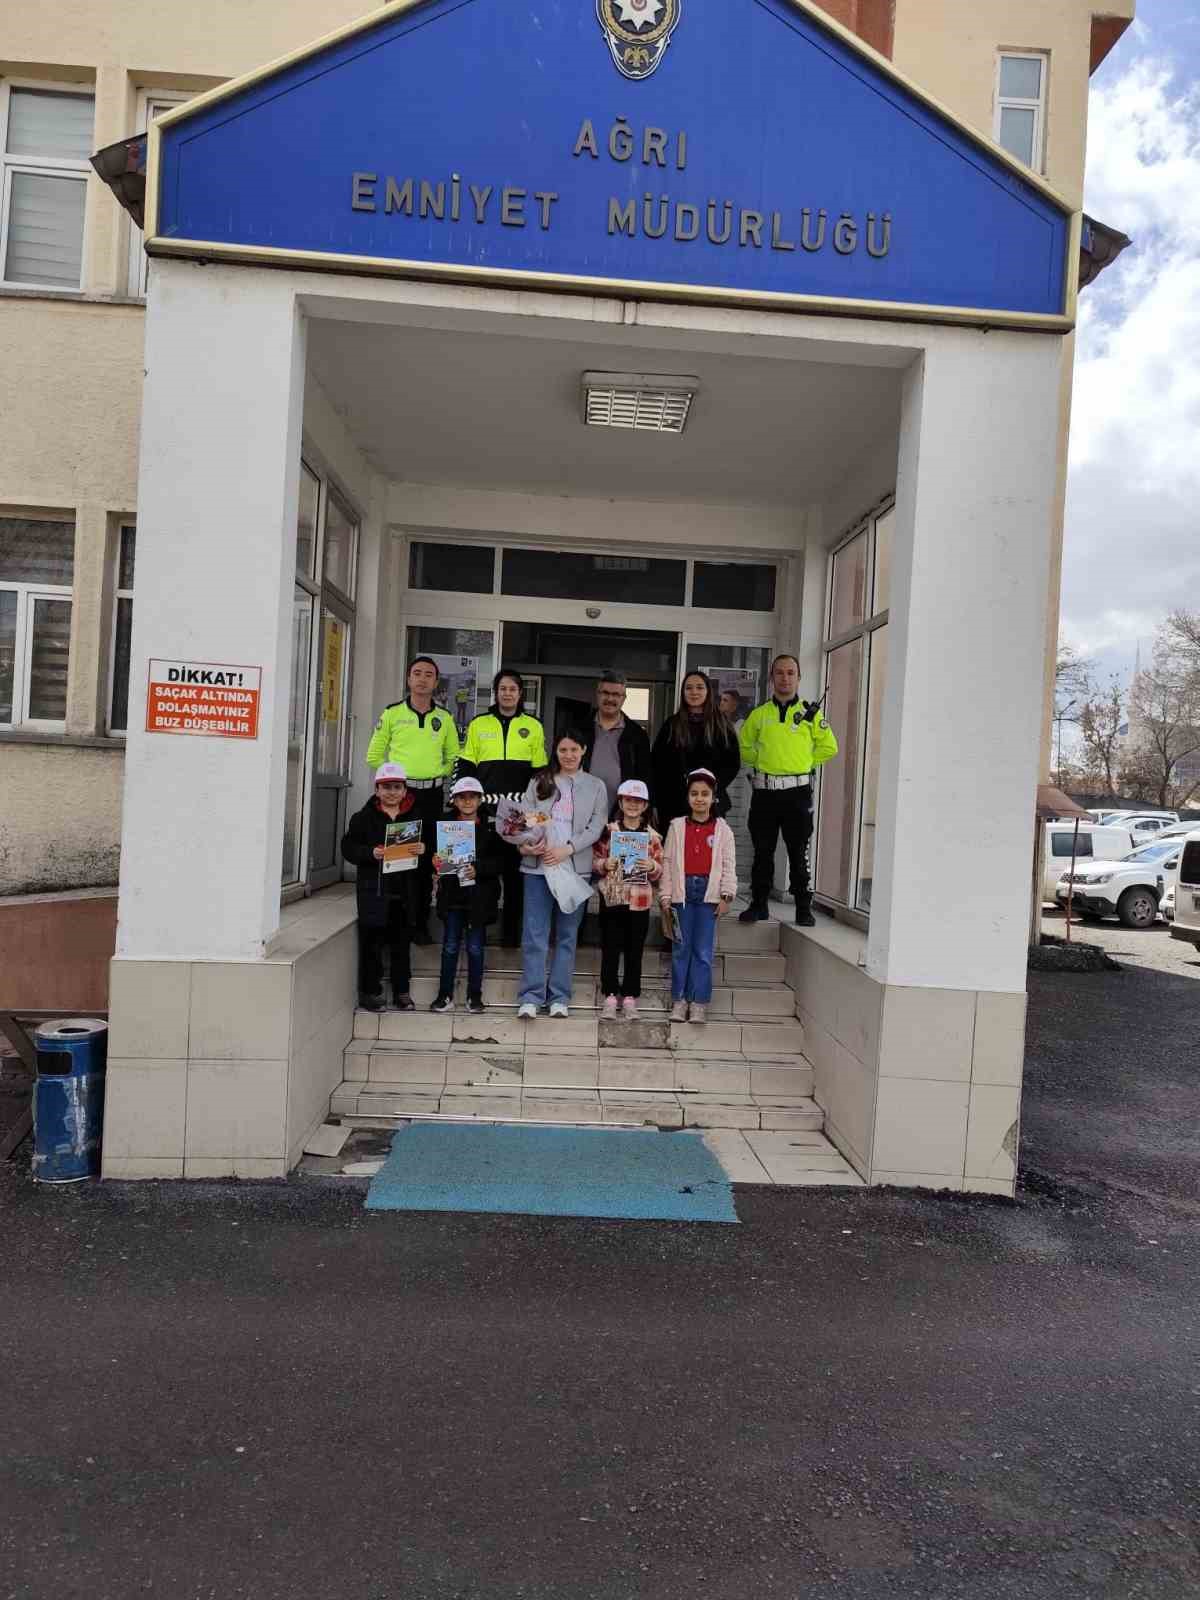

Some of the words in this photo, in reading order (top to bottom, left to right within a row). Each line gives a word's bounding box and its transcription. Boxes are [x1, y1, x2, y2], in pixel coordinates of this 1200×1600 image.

[572, 116, 688, 170] AĞRI
[351, 172, 559, 230] EMNİYET
[607, 192, 892, 258] MÜDÜRLÜĞÜ
[168, 666, 243, 687] DİKKAT!
[155, 687, 197, 700] SAÇAK
[201, 690, 253, 704] ALTINDA
[157, 702, 250, 718] DOLAŞMAYINIZ
[155, 716, 181, 728] BUZ
[184, 717, 249, 732] DÜŞEBİLİR
